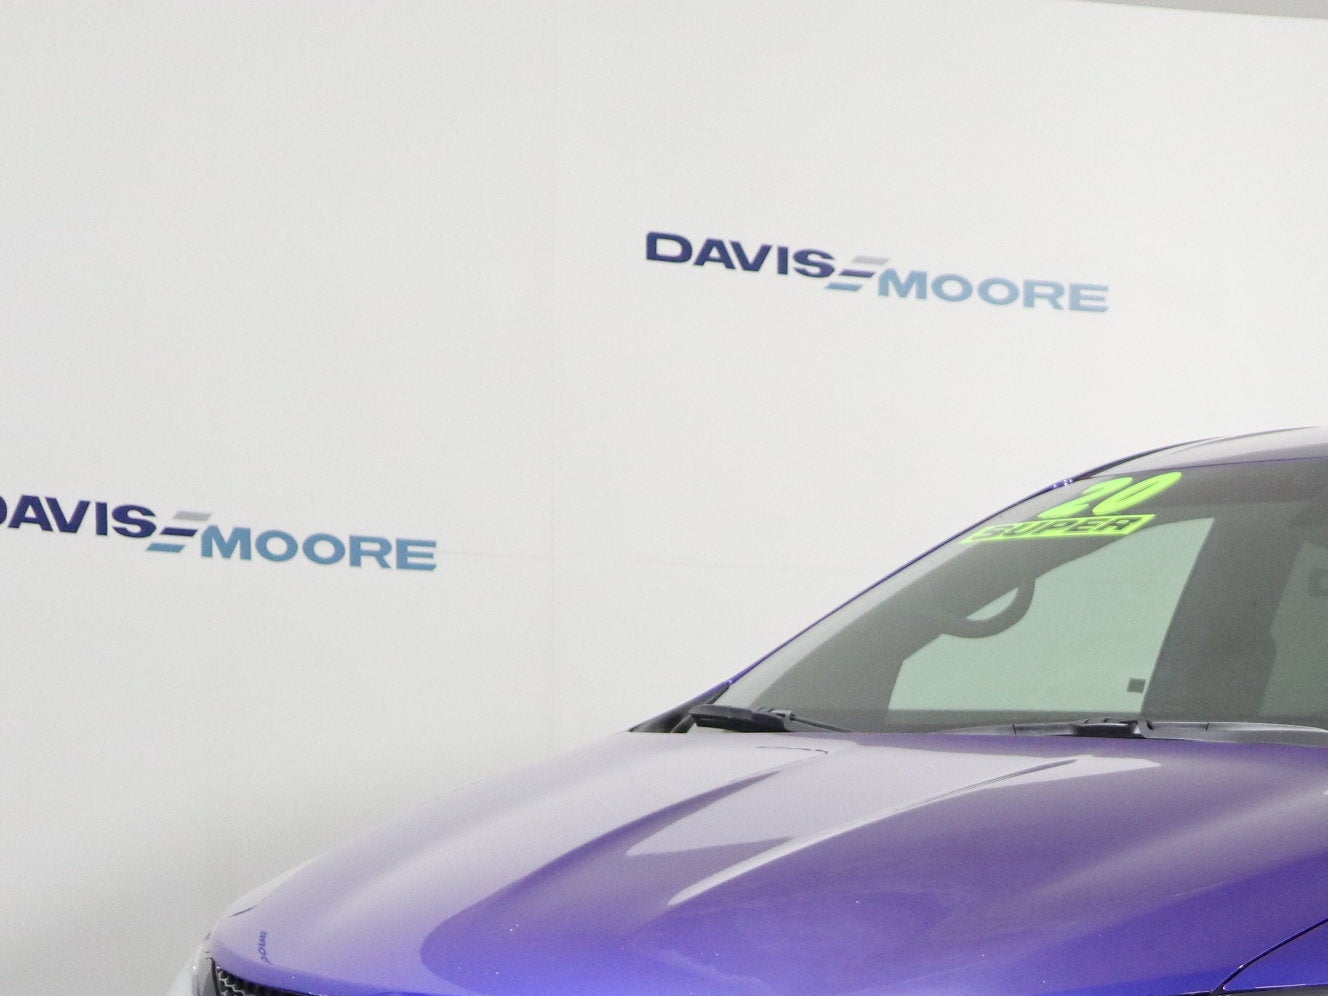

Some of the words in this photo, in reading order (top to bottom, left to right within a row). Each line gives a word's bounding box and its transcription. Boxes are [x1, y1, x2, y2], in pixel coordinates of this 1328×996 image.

[645, 231, 836, 279] DAVIS
[877, 267, 1110, 313] MOORE
[1038, 472, 1182, 518] 20
[0, 494, 157, 538] AVIS
[200, 524, 437, 571] MOORE
[970, 515, 1140, 541] SUPER
